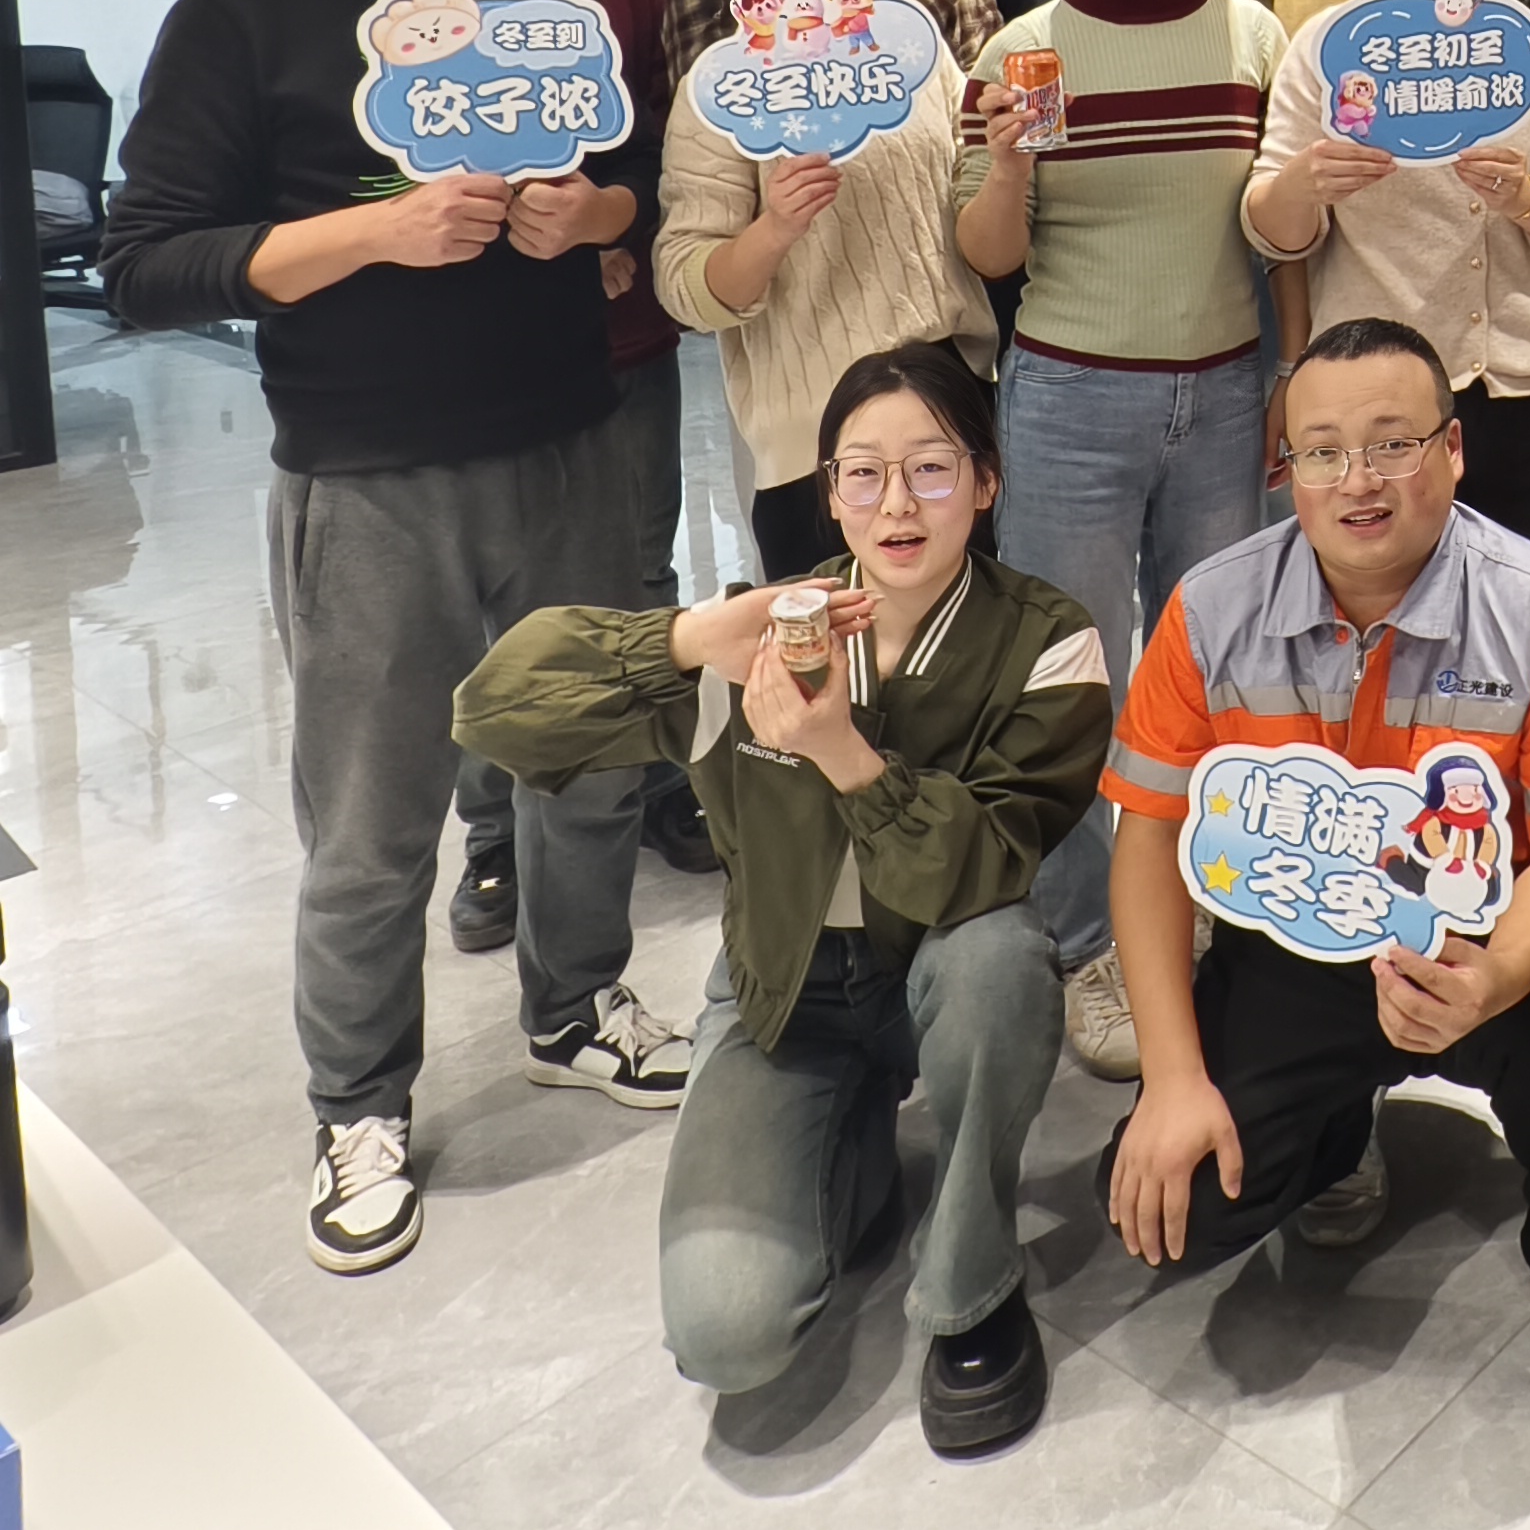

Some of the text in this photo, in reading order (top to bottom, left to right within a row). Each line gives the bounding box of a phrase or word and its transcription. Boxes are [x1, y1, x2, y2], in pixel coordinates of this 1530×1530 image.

[493, 20, 586, 50] 冬至到
[1360, 29, 1505, 72] 冬至初至
[405, 75, 601, 137] 饺子浓
[715, 55, 905, 116] 冬至快乐
[1383, 72, 1525, 117] 情暖俞浓
[1240, 767, 1388, 866] 情满
[1247, 848, 1394, 937] 冬季
